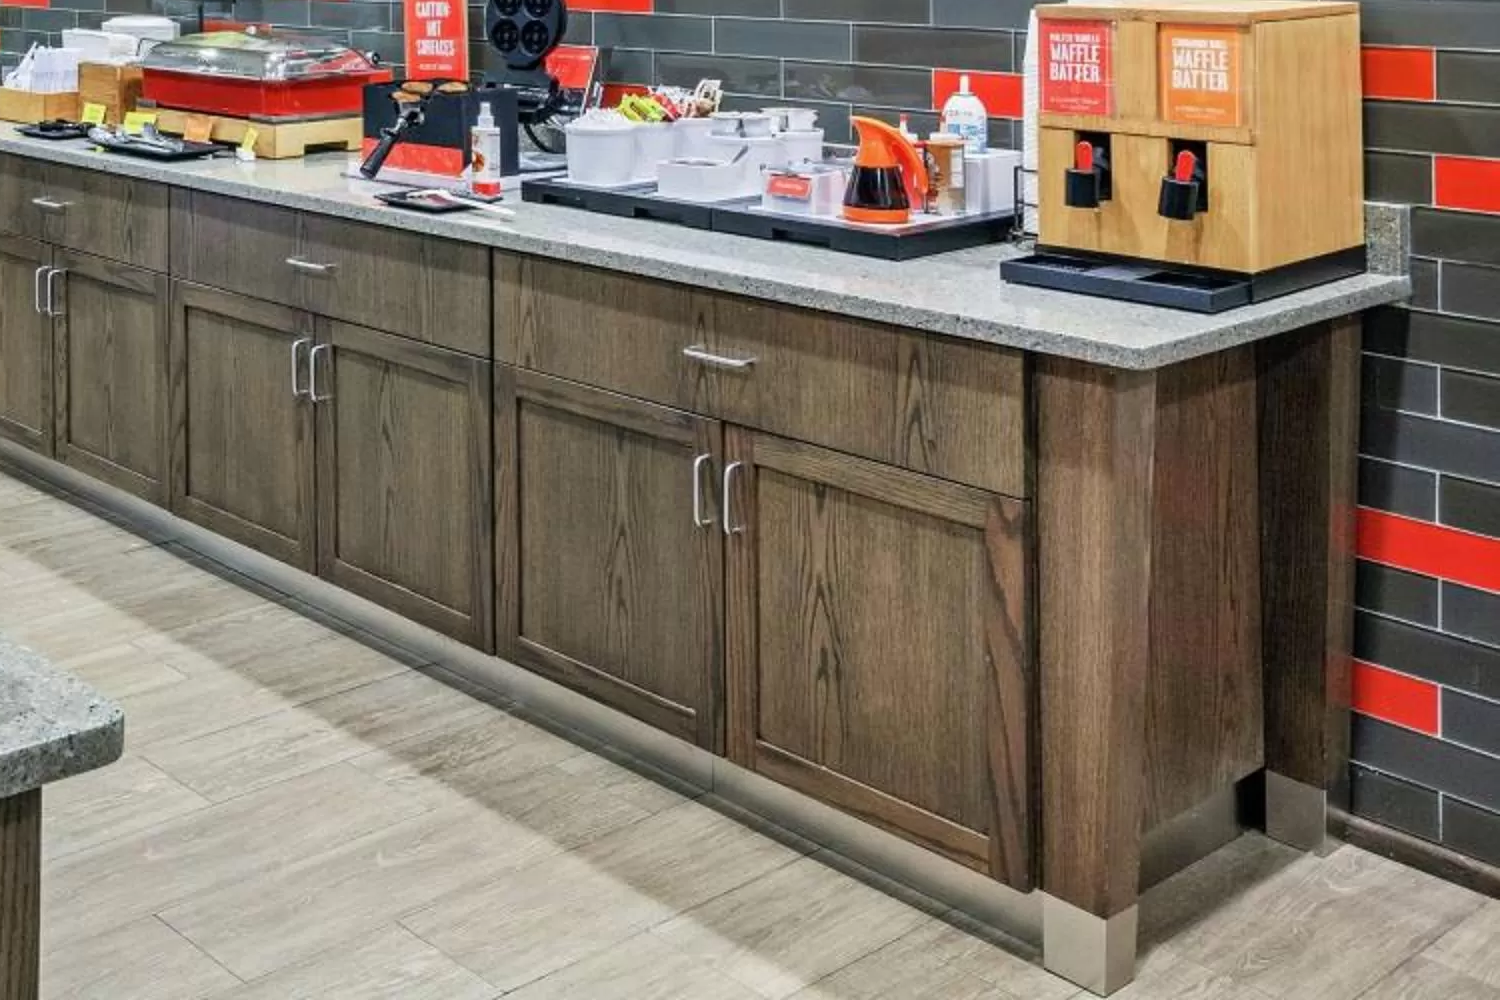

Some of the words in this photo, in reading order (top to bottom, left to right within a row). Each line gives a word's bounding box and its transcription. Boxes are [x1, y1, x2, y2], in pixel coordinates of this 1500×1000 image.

[1049, 43, 1100, 63] WAFFLE
[1171, 48, 1229, 70] WAFFLE
[1049, 62, 1100, 83] BATTER
[1171, 69, 1229, 91] BATTER
